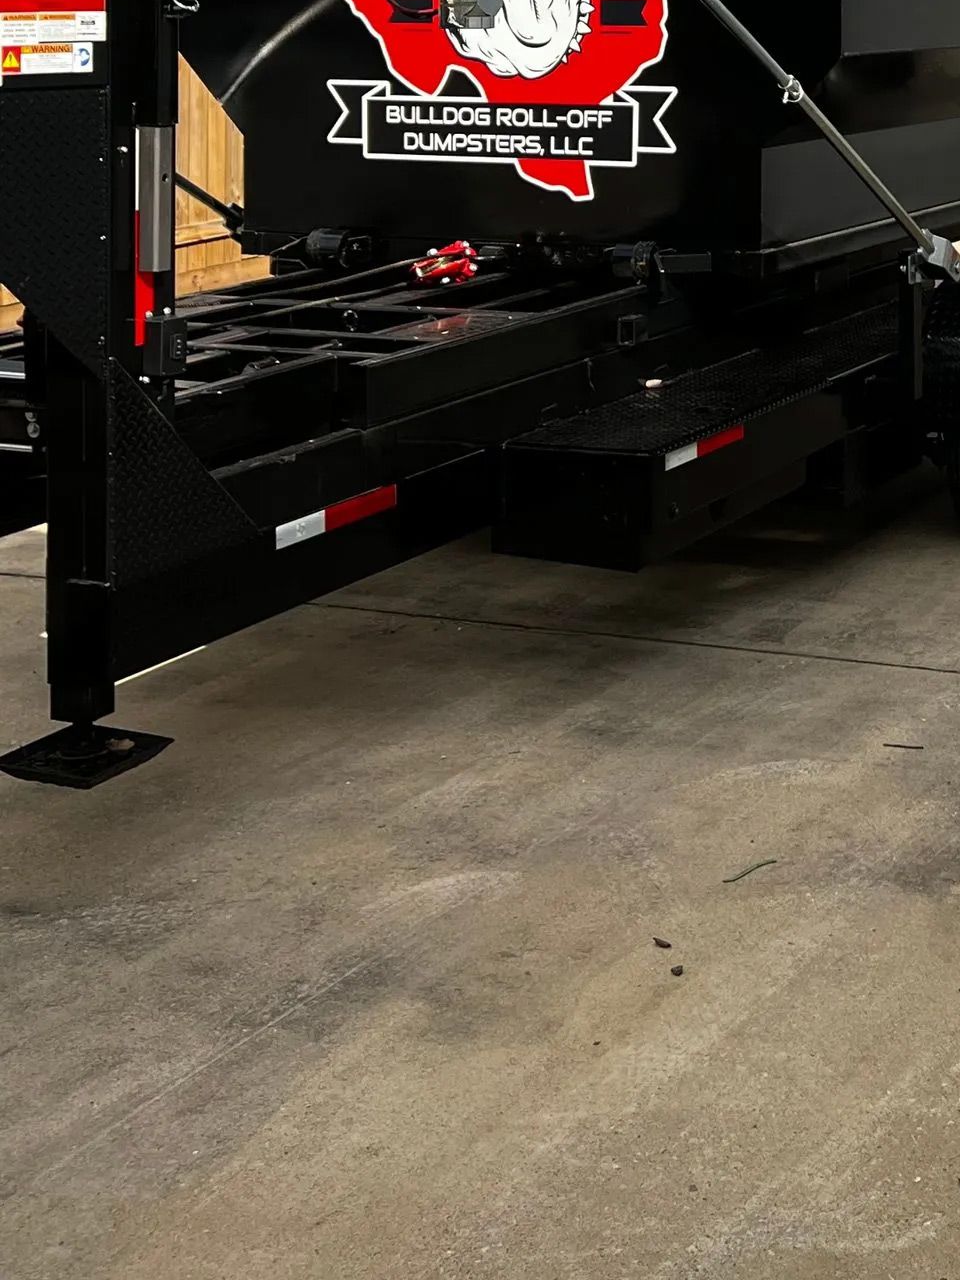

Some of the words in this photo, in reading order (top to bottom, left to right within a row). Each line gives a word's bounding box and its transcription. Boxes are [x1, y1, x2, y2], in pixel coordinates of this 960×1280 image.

[31, 44, 71, 53] WARNING
[386, 106, 490, 125] BULLDOG
[496, 108, 613, 128] ROLL-OFF
[404, 132, 544, 155] DUMPSTERS,
[551, 136, 593, 155] LLC
